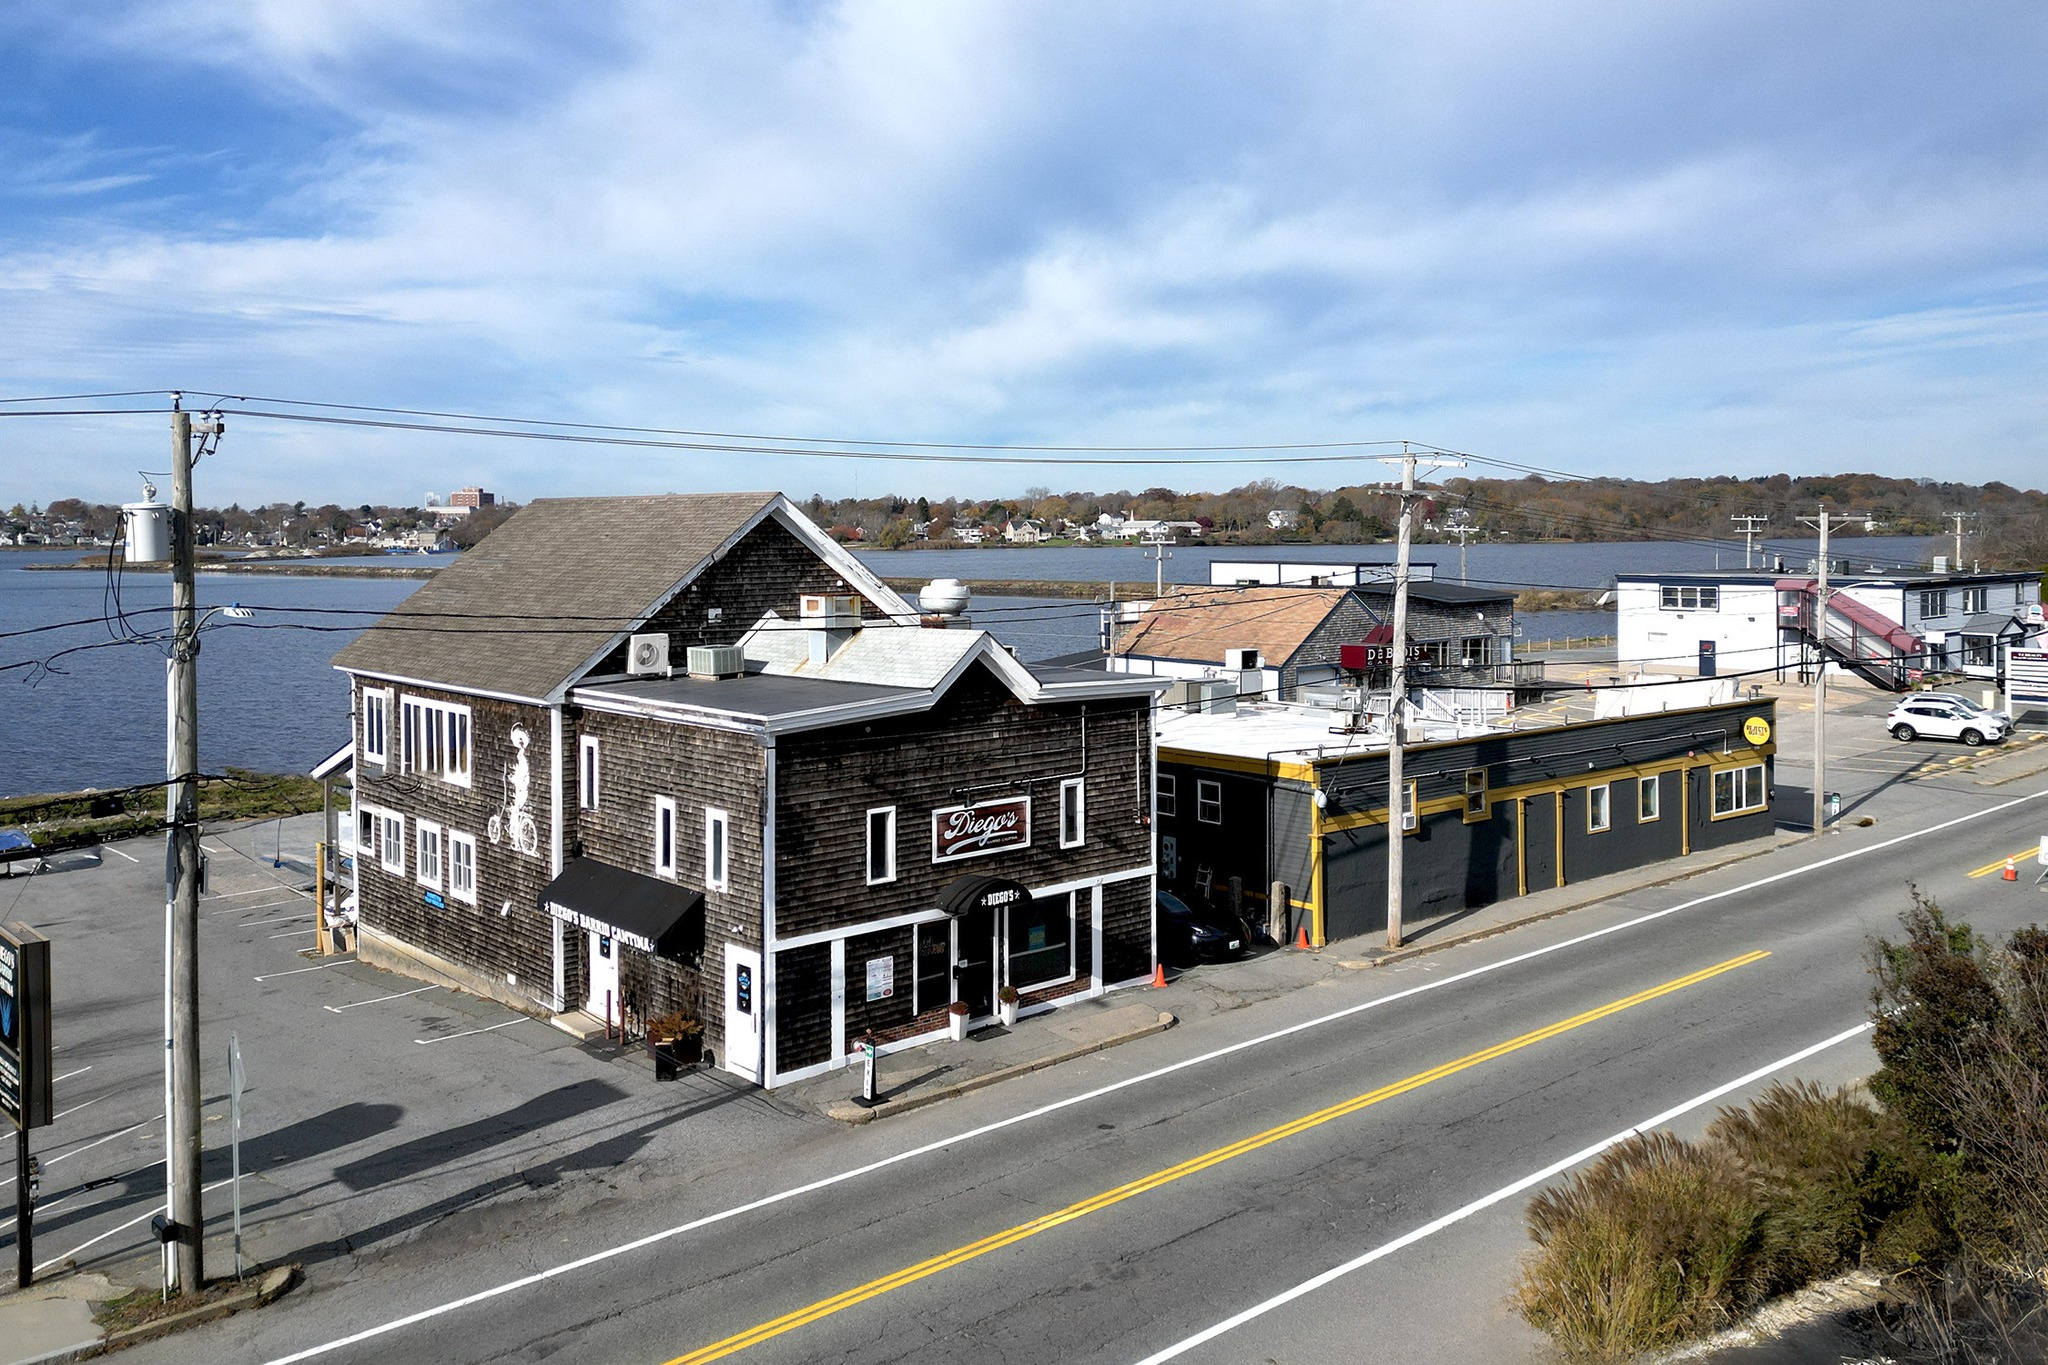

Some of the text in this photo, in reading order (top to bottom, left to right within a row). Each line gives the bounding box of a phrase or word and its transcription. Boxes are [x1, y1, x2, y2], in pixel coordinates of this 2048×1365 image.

[944, 810, 1019, 847] Diego's
[987, 889, 1014, 906] DIEGO'S
[549, 901, 651, 952] DIEGO'S BARRIO CANTINA
